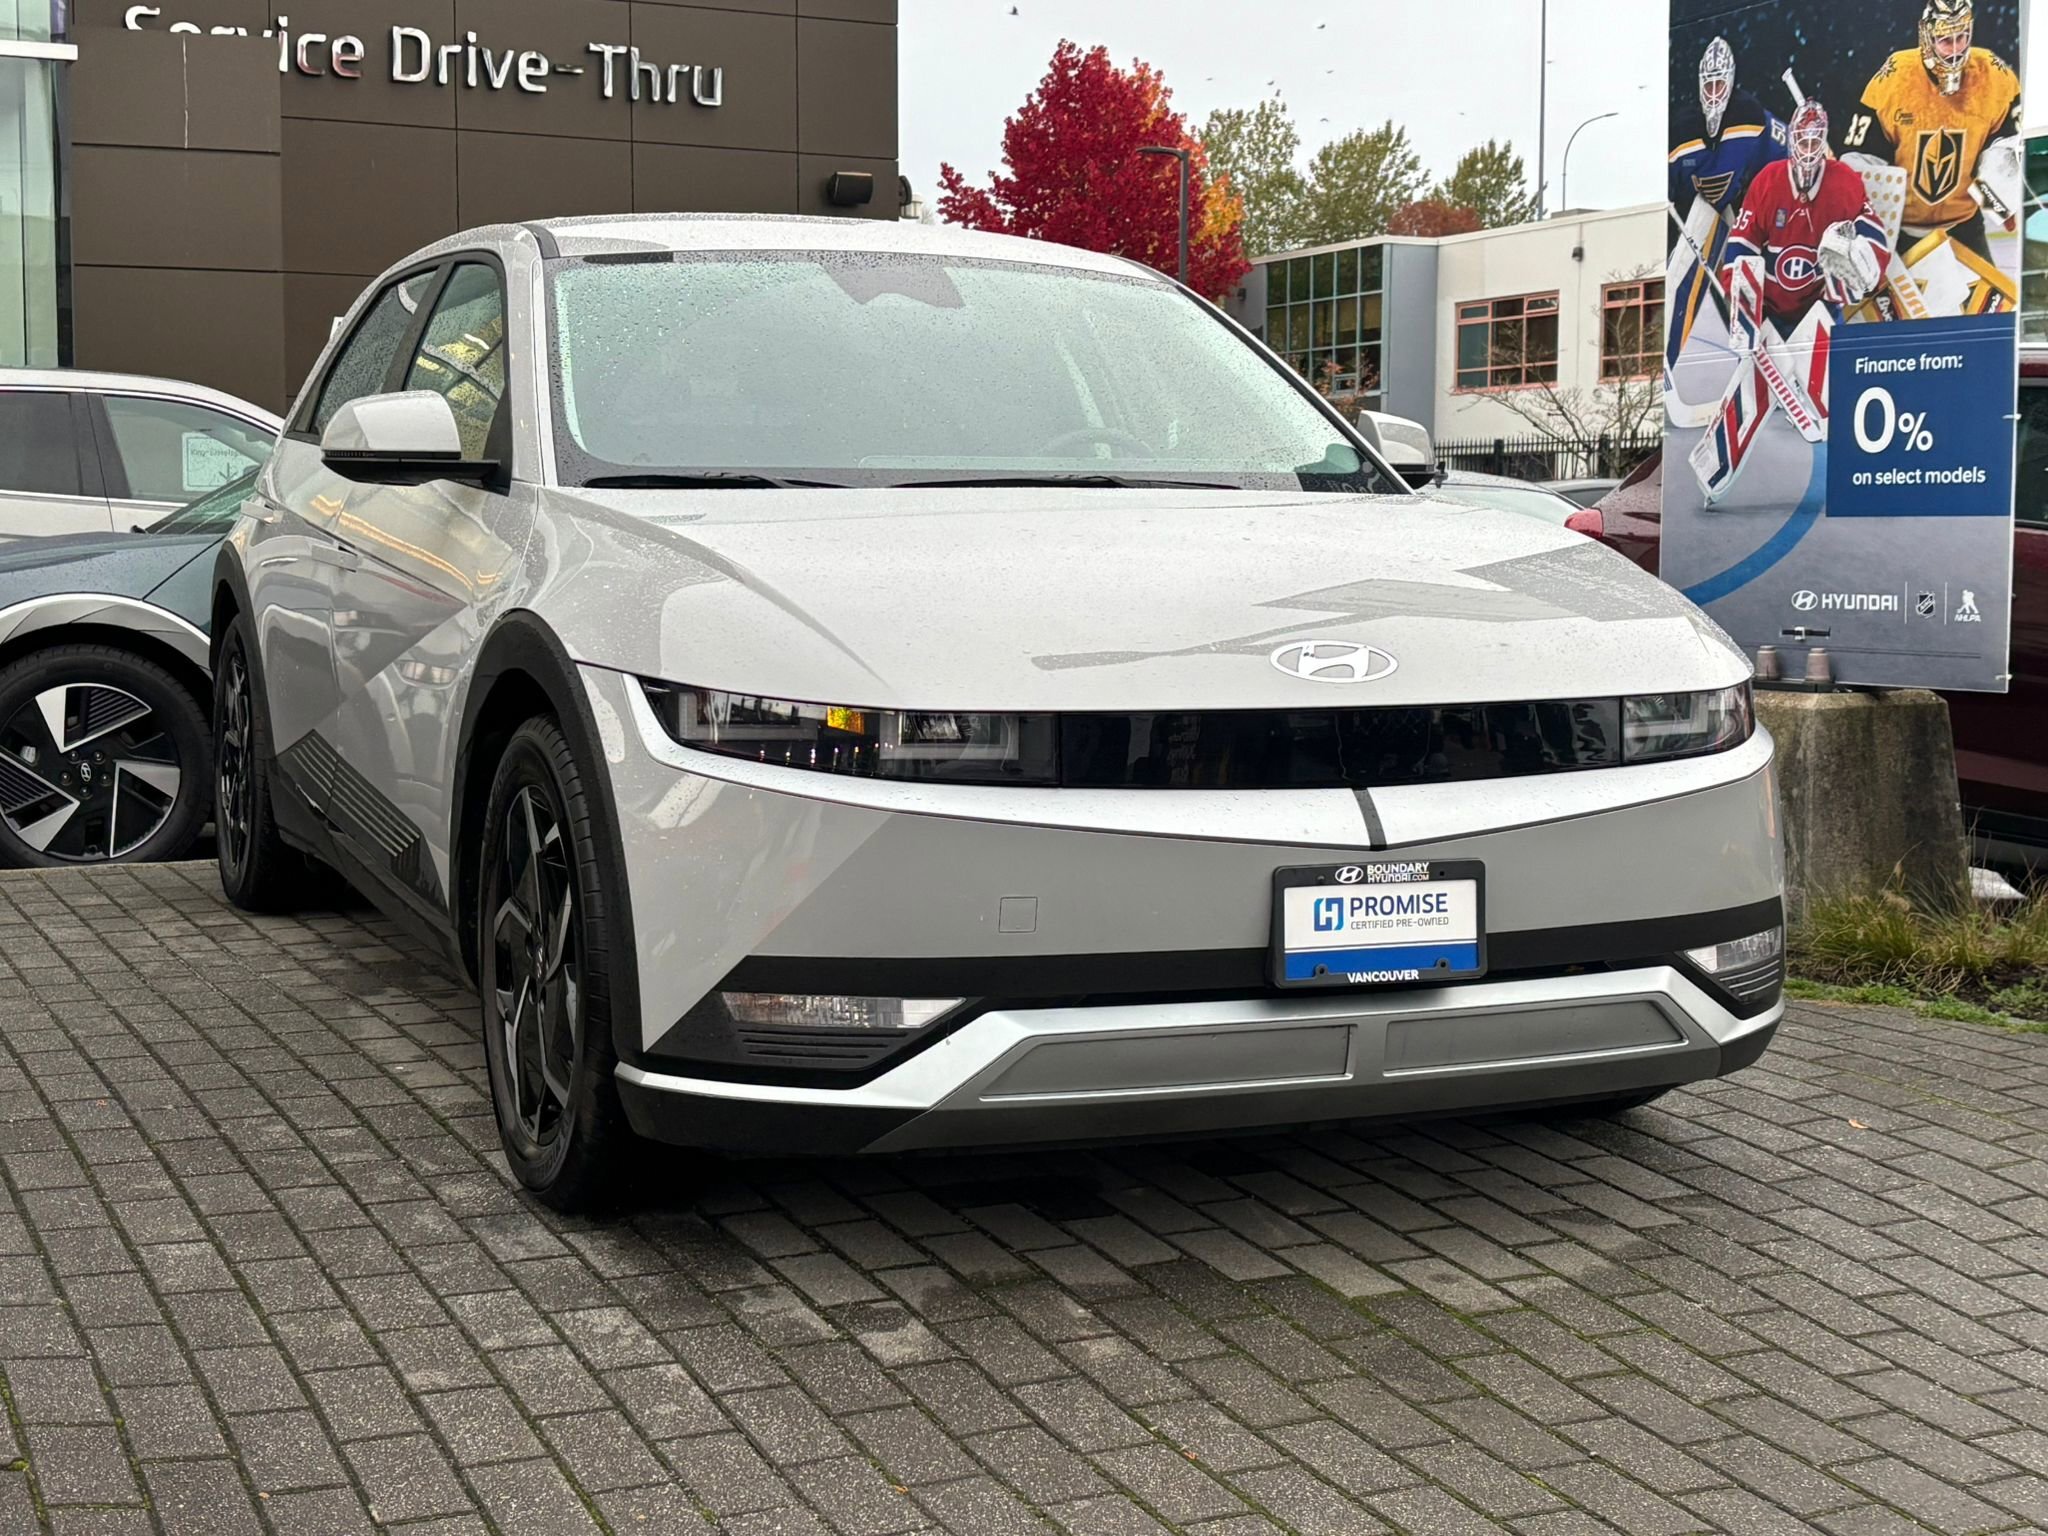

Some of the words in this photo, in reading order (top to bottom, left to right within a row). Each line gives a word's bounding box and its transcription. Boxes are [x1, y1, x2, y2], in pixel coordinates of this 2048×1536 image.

[125, 5, 366, 78] Sice
[392, 25, 724, 108] Drive-Thru
[1855, 357, 1917, 375] Finance
[1919, 353, 1964, 371] from:
[1853, 386, 1934, 454] 0%
[1852, 472, 1872, 486] on
[1875, 468, 1923, 485] select
[1925, 466, 1987, 484] models
[1821, 593, 1899, 611] HYUNDAI
[1366, 861, 1430, 875] BOUNDARY
[1350, 892, 1449, 917] PROMISE
[1350, 919, 1394, 930] CERTIFIED
[1395, 916, 1449, 928] PRE-OWNED
[1347, 969, 1420, 984] VANCOUVER
